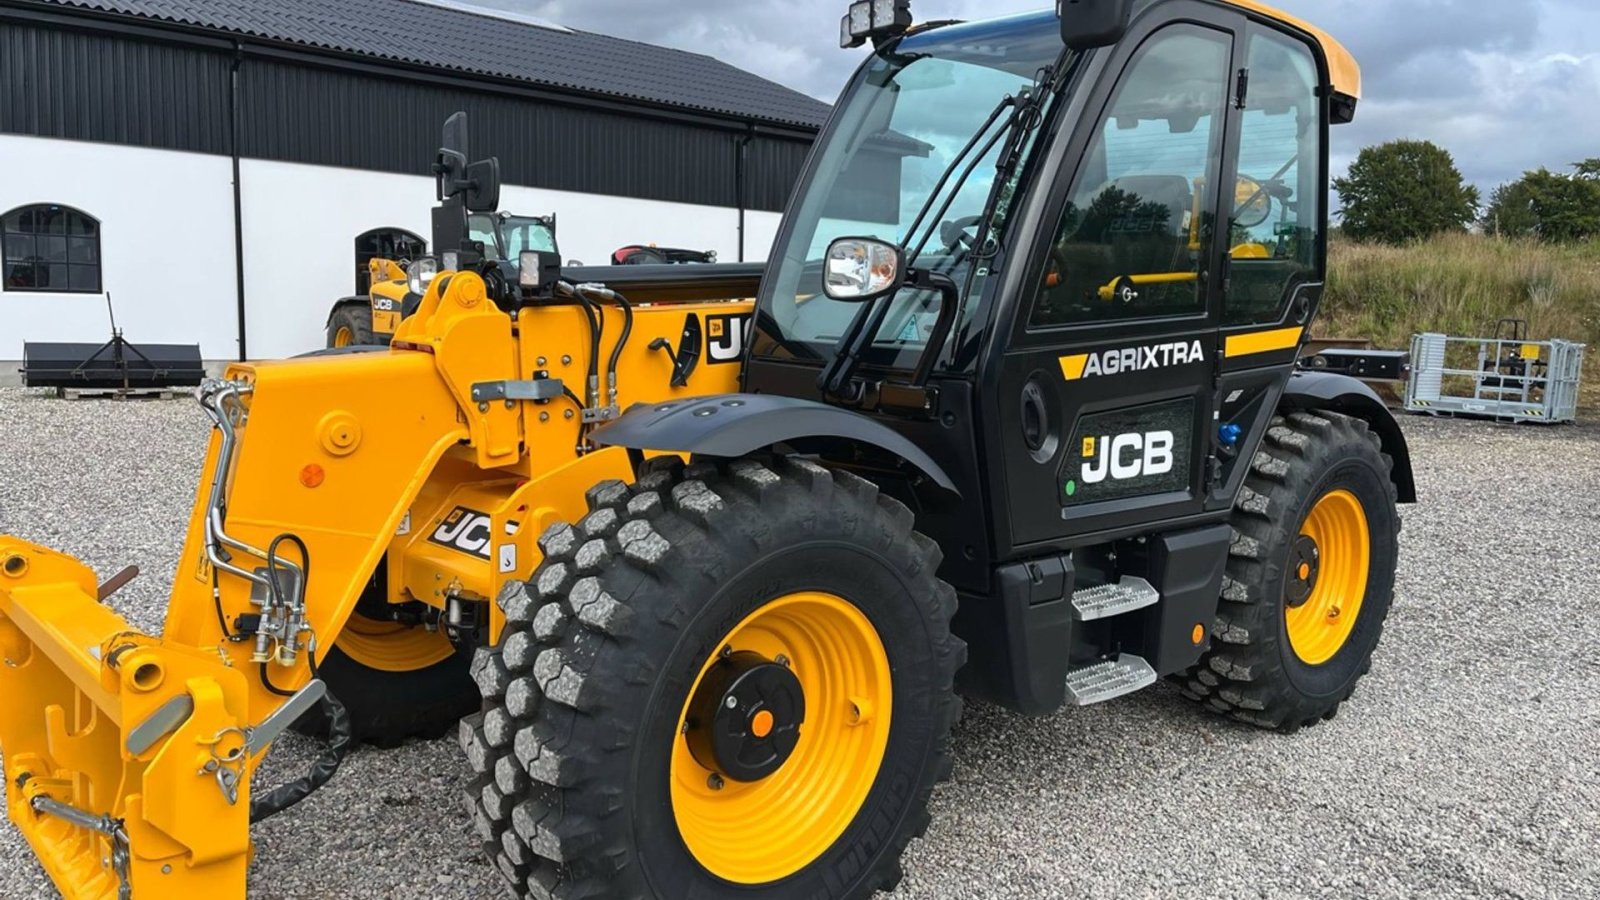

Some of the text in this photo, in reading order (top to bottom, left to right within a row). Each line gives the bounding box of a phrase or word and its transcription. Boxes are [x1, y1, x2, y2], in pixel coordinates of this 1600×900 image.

[374, 298, 392, 310] JCB
[709, 317, 752, 360] J
[1082, 340, 1204, 379] AGRIXTRA
[1081, 430, 1174, 483] JCB
